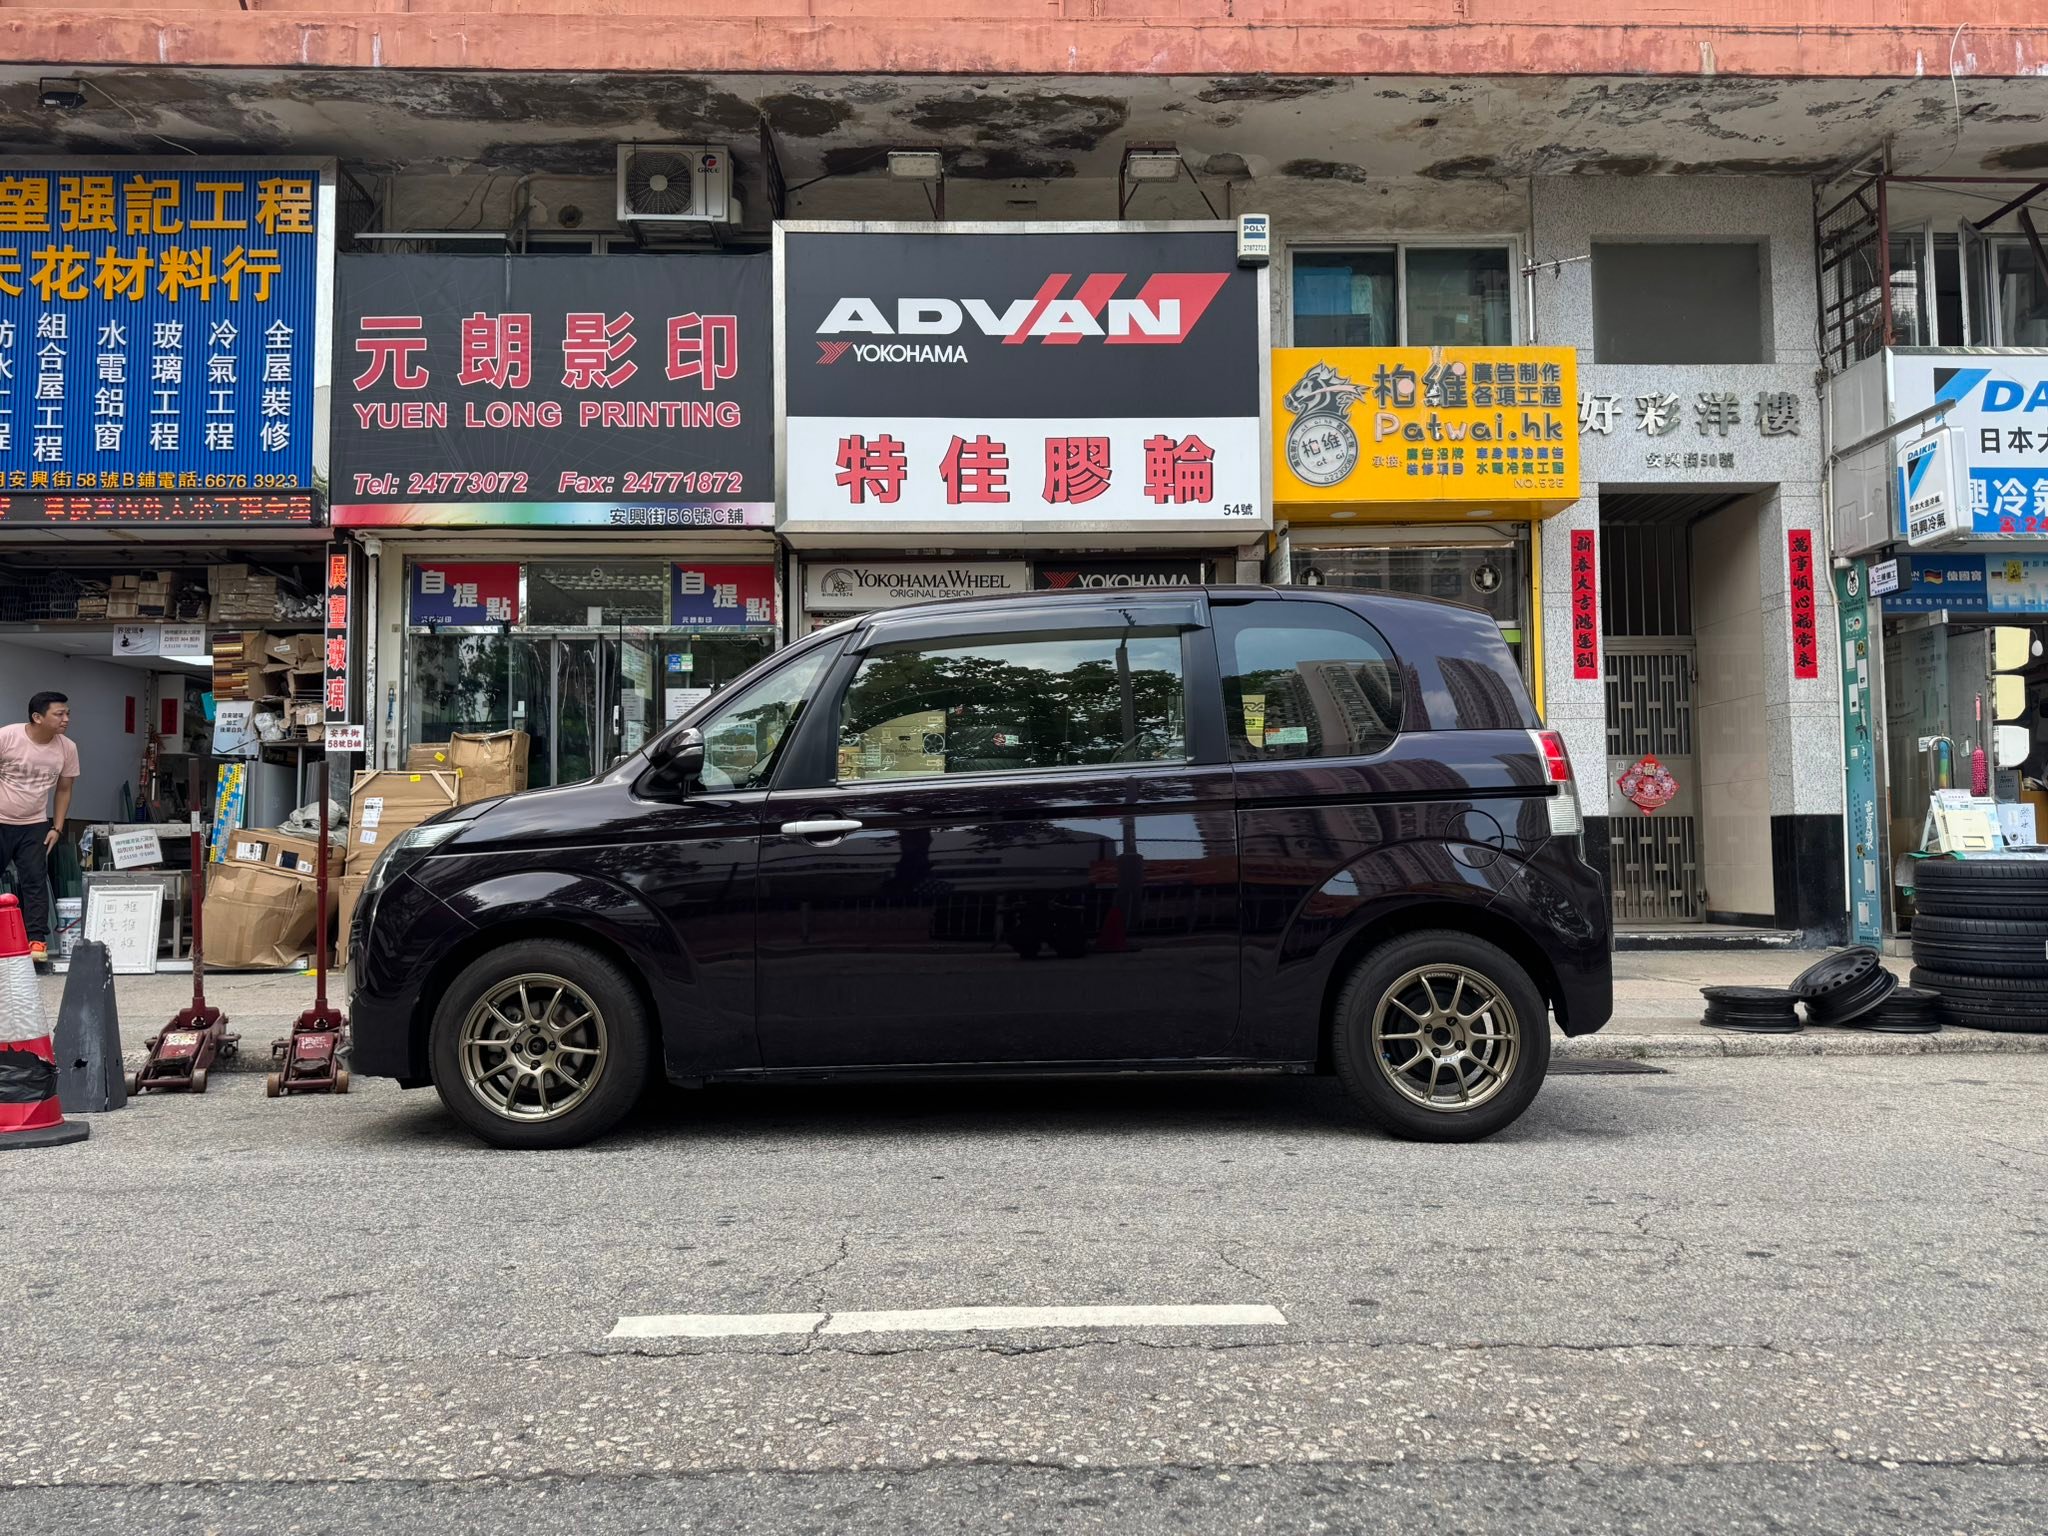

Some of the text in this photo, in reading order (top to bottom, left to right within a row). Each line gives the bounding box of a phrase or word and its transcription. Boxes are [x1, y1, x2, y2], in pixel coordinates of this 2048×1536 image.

[816, 297, 1181, 335] ADVAN
[353, 312, 738, 391] 元朗影印
[853, 344, 968, 363] YOKOHAMA
[33, 312, 68, 462] 組合屋工程
[94, 319, 127, 451] 水電鋁窗
[150, 319, 184, 451] 玻璃工程
[204, 319, 238, 451] 冷氣工程
[260, 319, 294, 451] 全屋裝修
[1473, 363, 1562, 384] 廣告制作
[1472, 385, 1562, 407] 各項工程
[353, 402, 741, 429] YUEN LONG PRINTING
[1374, 412, 1562, 442] Patwai.hk
[1579, 391, 1800, 436] 好彩洋樓
[1907, 441, 1938, 460] DAIKIN
[354, 472, 742, 495] Tel: 24773072 Fax: 24771872
[835, 434, 1214, 504] 特佳膠輪
[1223, 504, 1253, 516] 54號
[421, 570, 511, 622] 自提點
[681, 571, 770, 621] 自提點
[854, 569, 1011, 589] YOKOHAMA WHEEL
[890, 589, 936, 598] ORIGINAL
[1078, 573, 1190, 587] YOKOHAMA
